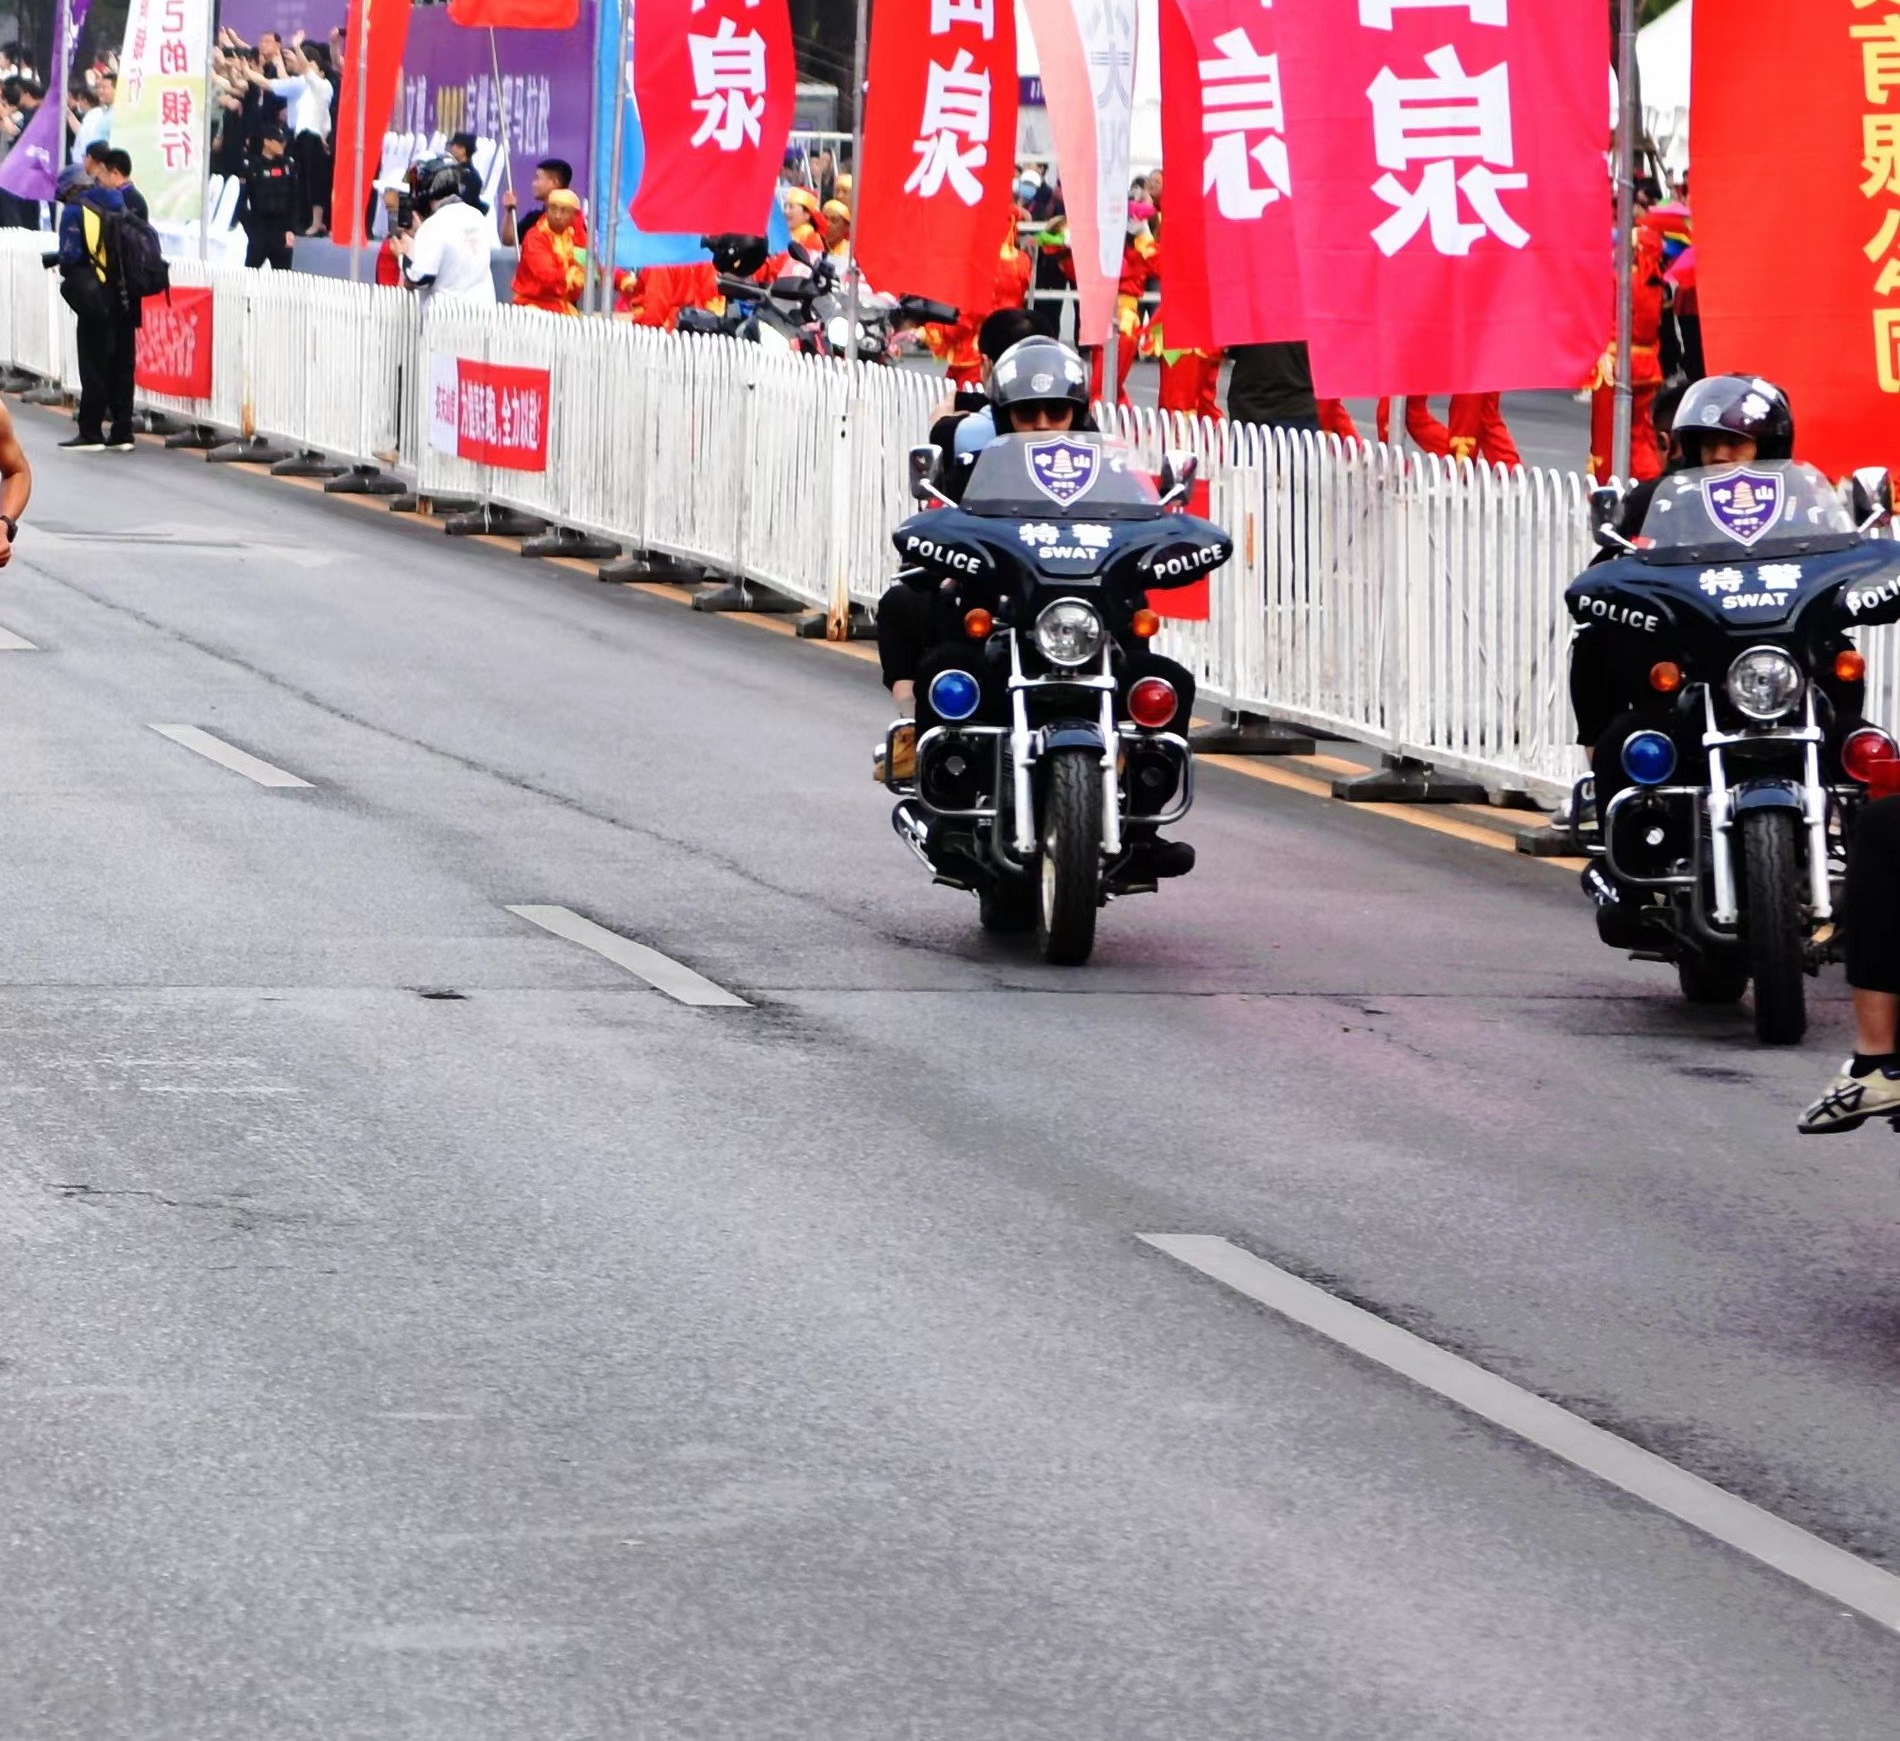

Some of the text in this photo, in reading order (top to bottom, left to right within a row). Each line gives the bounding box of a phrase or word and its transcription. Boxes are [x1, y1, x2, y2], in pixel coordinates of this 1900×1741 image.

[1018, 522, 1112, 547] 特警
[905, 535, 982, 575] POLICE
[1038, 546, 1100, 560] SWAT
[1152, 543, 1224, 580] POLICE
[1699, 562, 1802, 596] 特警
[1845, 573, 1900, 616] POLI
[1578, 594, 1659, 633] POLICE
[1721, 592, 1789, 609] SWAT
